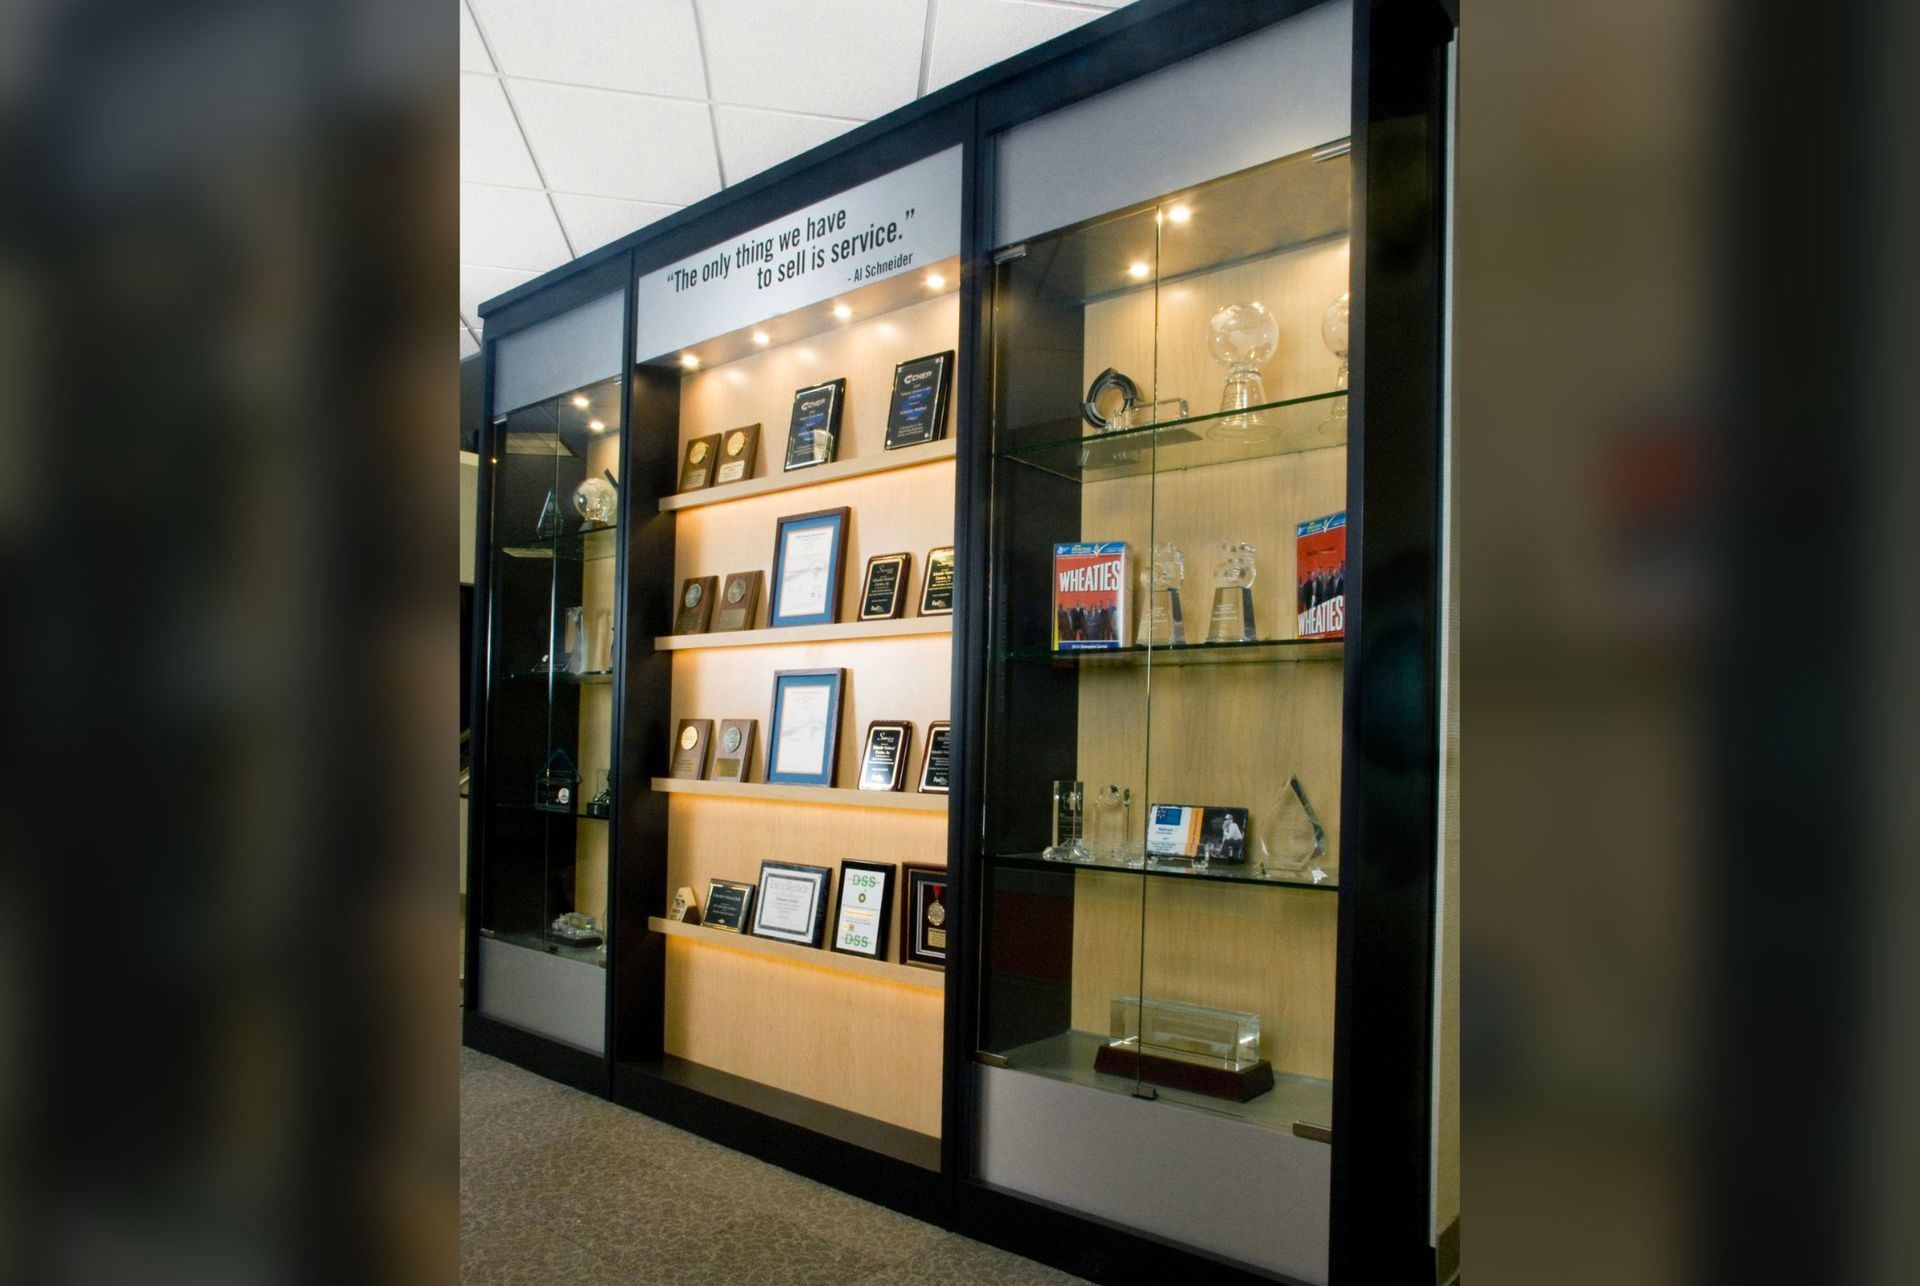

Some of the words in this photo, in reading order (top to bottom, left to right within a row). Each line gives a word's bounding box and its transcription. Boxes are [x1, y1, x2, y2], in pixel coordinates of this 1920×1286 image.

[667, 268, 698, 293] “The
[702, 252, 731, 282] only
[736, 240, 774, 268] thing
[779, 227, 800, 252] we
[807, 209, 846, 242] have
[757, 267, 772, 289] to
[778, 249, 805, 282] sell
[812, 245, 825, 271] is
[854, 267, 862, 282] Al
[865, 252, 913, 279] Schneider
[1059, 560, 1121, 593] WHEATIES
[1298, 595, 1344, 635] WHEATIES
[852, 874, 876, 888] DSS
[845, 933, 869, 947] DSS
